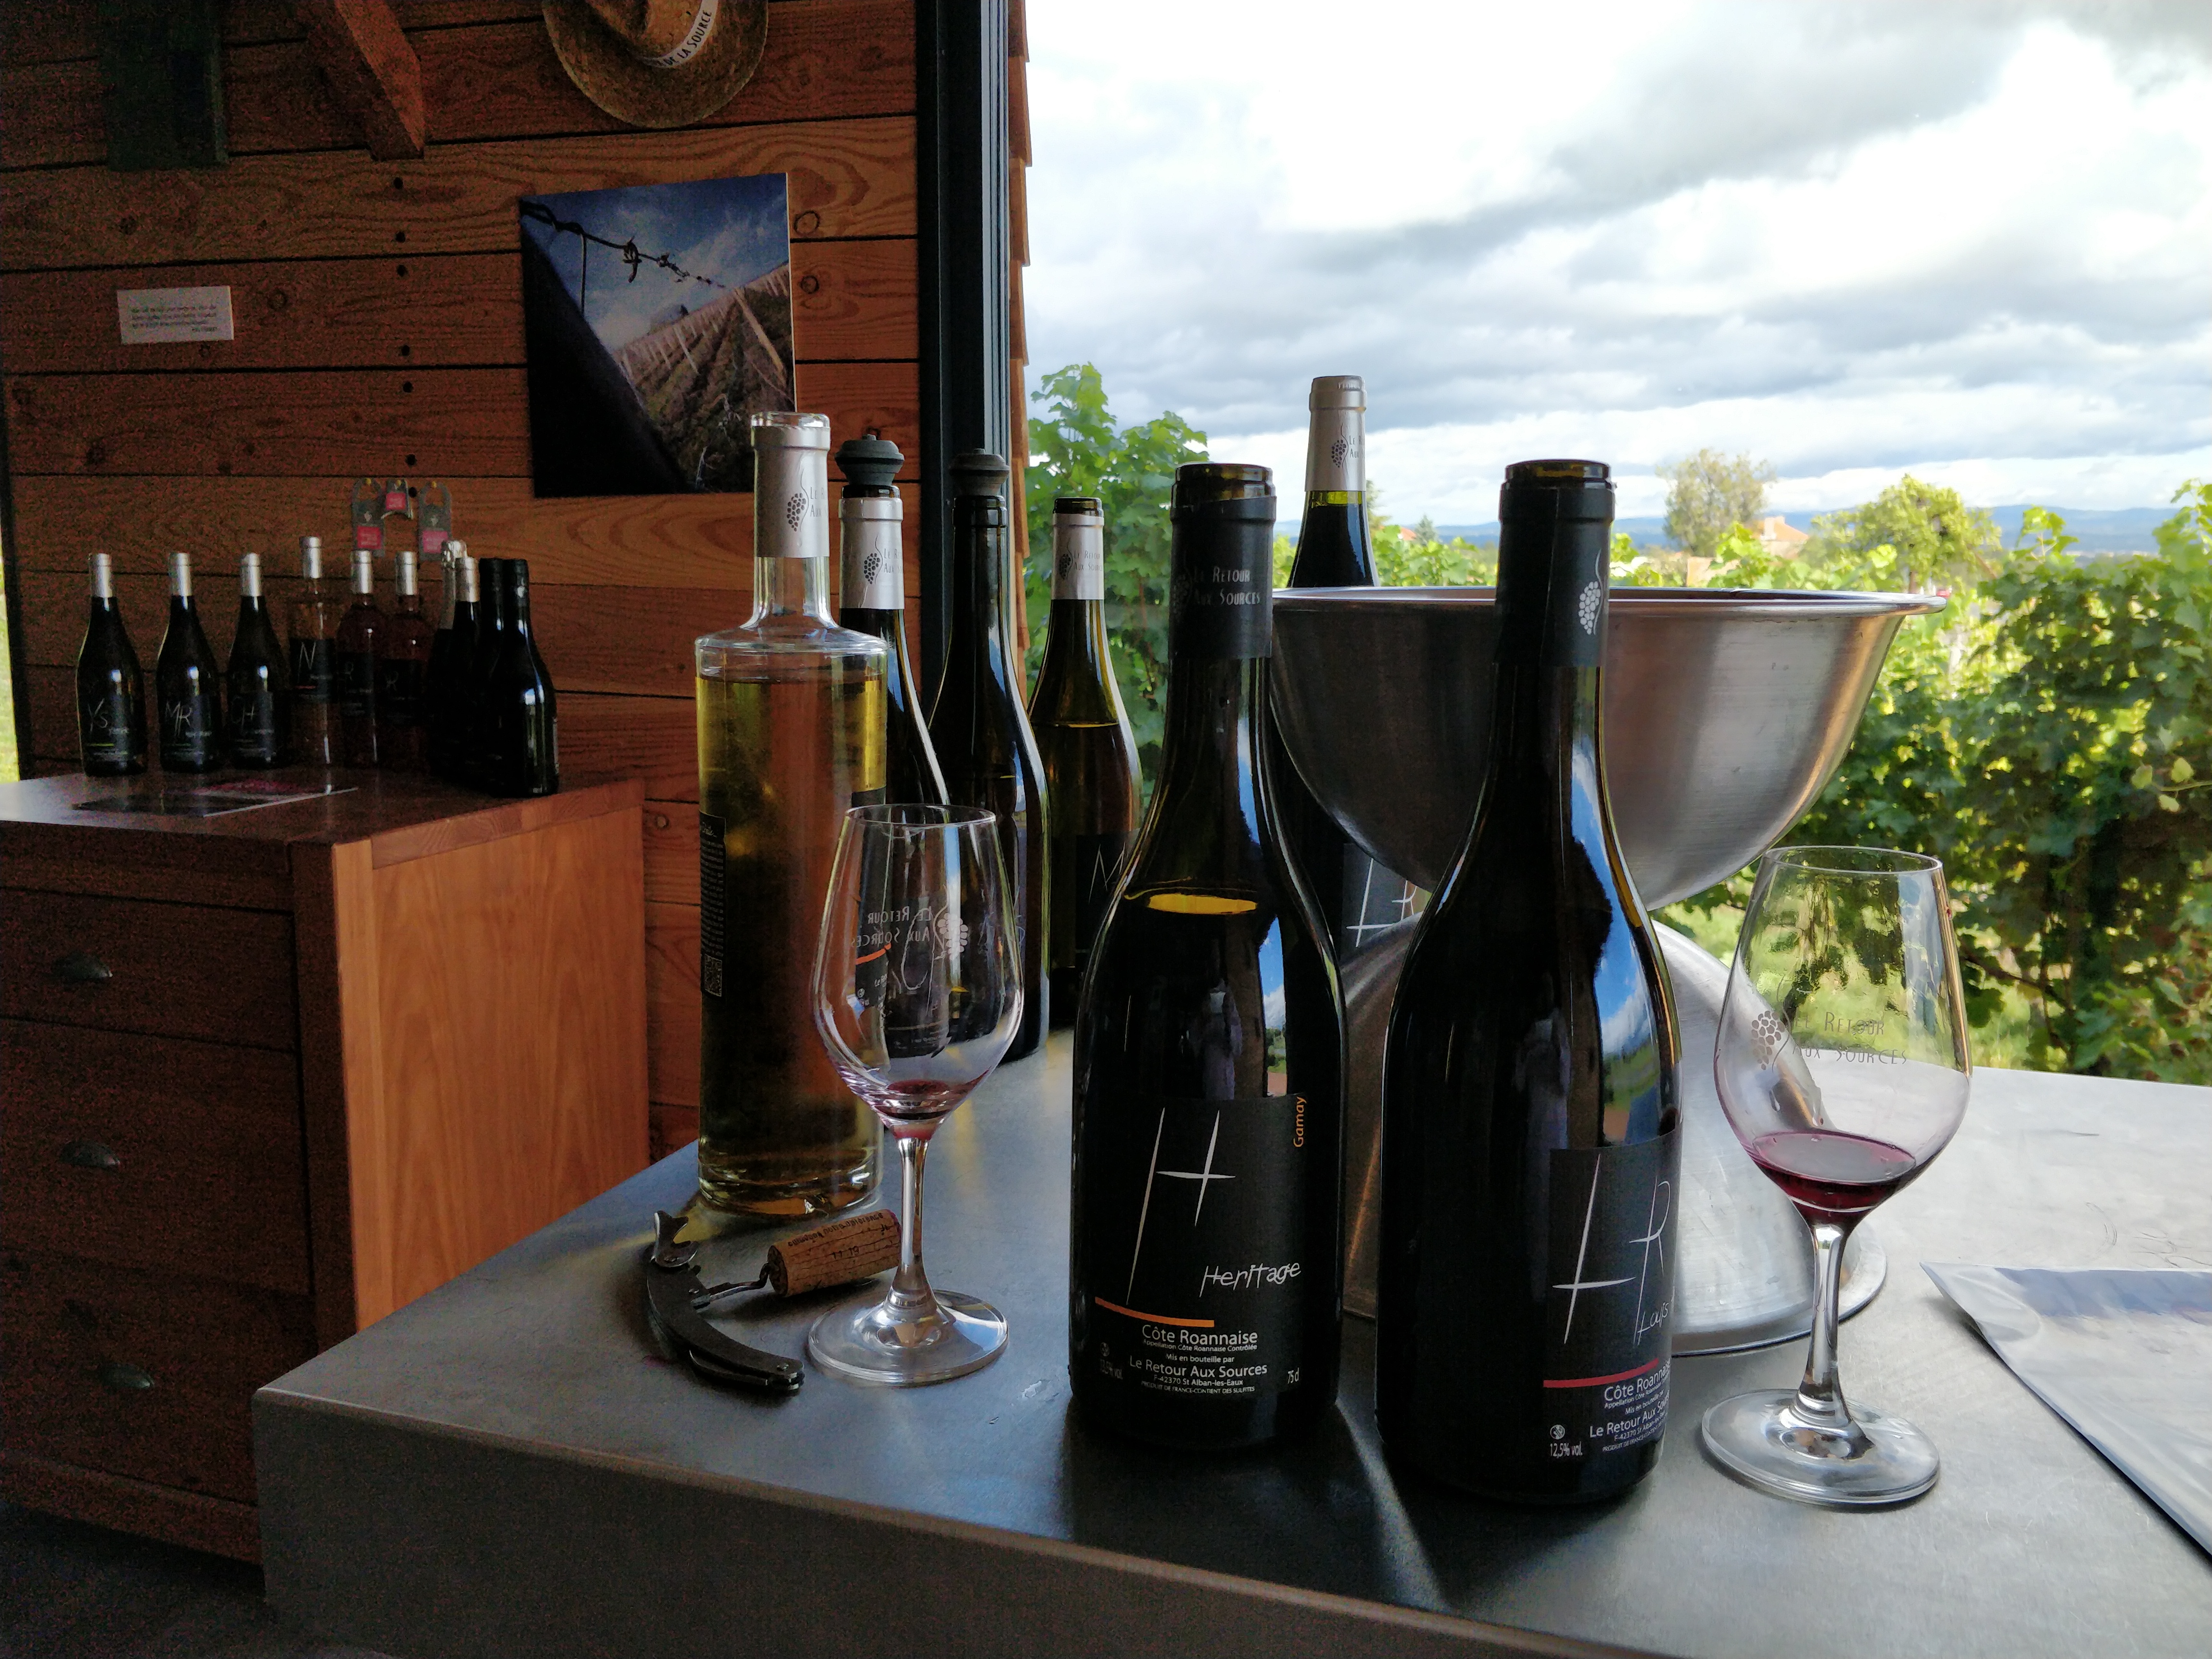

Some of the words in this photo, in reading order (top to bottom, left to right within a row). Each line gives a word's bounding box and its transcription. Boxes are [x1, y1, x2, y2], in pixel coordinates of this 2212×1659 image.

[676, 48, 692, 59] LA
[686, 10, 712, 48] SOURCE
[1293, 1096, 1306, 1148] Gamay
[1142, 1324, 1175, 1343] Côte
[1180, 1329, 1258, 1346] Roannaise
[1227, 1344, 1258, 1352] Contrôlée
[1130, 1355, 1142, 1369] Le
[1146, 1358, 1187, 1377] Retour
[1190, 1365, 1215, 1378] Aux
[1218, 1363, 1268, 1378] Sources
[1166, 1353, 1178, 1361] Mis
[1190, 1355, 1221, 1363] bouteille
[1154, 1374, 1181, 1385] F-42370
[1191, 1378, 1243, 1387] Alban-les-Eaux
[1604, 1384, 1634, 1402] Côte
[1604, 1397, 1635, 1409] Appellation
[1625, 1407, 1635, 1415] Mis
[1589, 1425, 1604, 1438] Le
[1607, 1415, 1641, 1435] Retour
[1642, 1407, 1656, 1424] Aux
[1614, 1429, 1636, 1442] F-42370
[1550, 1442, 1570, 1459] 12,5%
[1571, 1441, 1583, 1456] vol.
